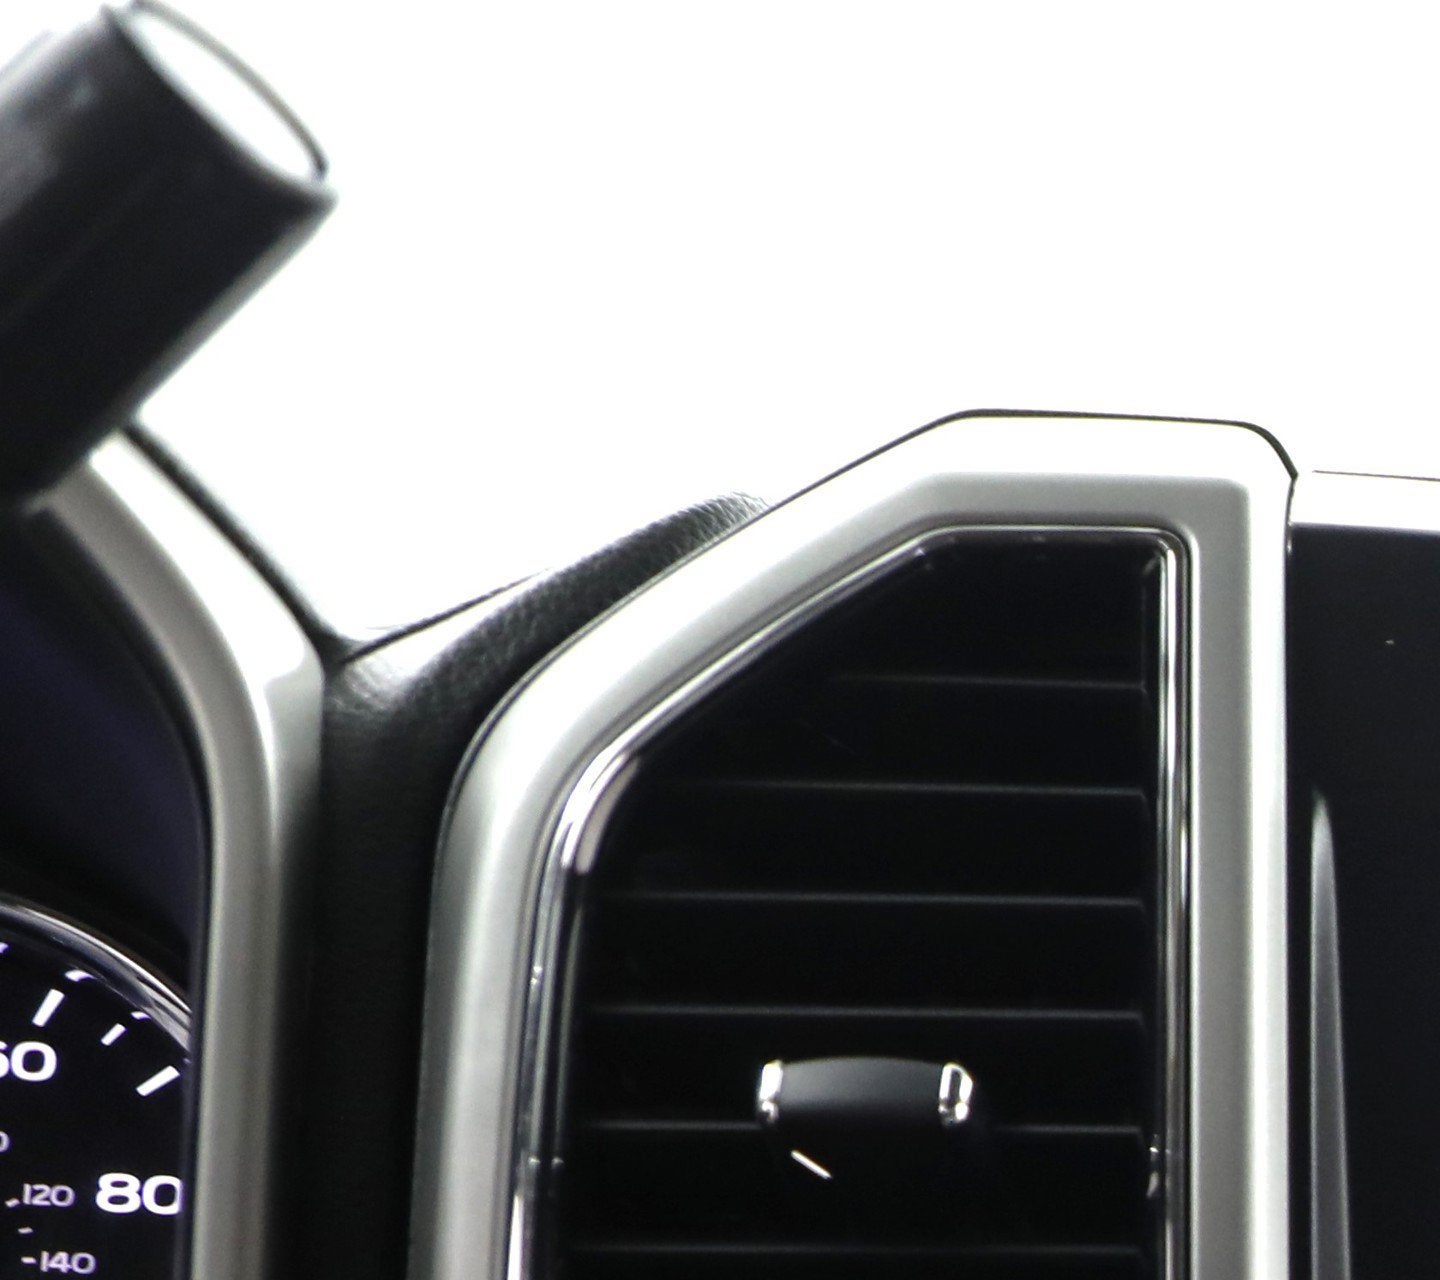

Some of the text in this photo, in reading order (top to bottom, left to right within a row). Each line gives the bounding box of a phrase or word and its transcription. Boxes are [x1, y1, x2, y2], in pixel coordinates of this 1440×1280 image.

[22, 1183, 76, 1208] 120
[95, 1172, 185, 1216] 80
[40, 1250, 97, 1275] 140
